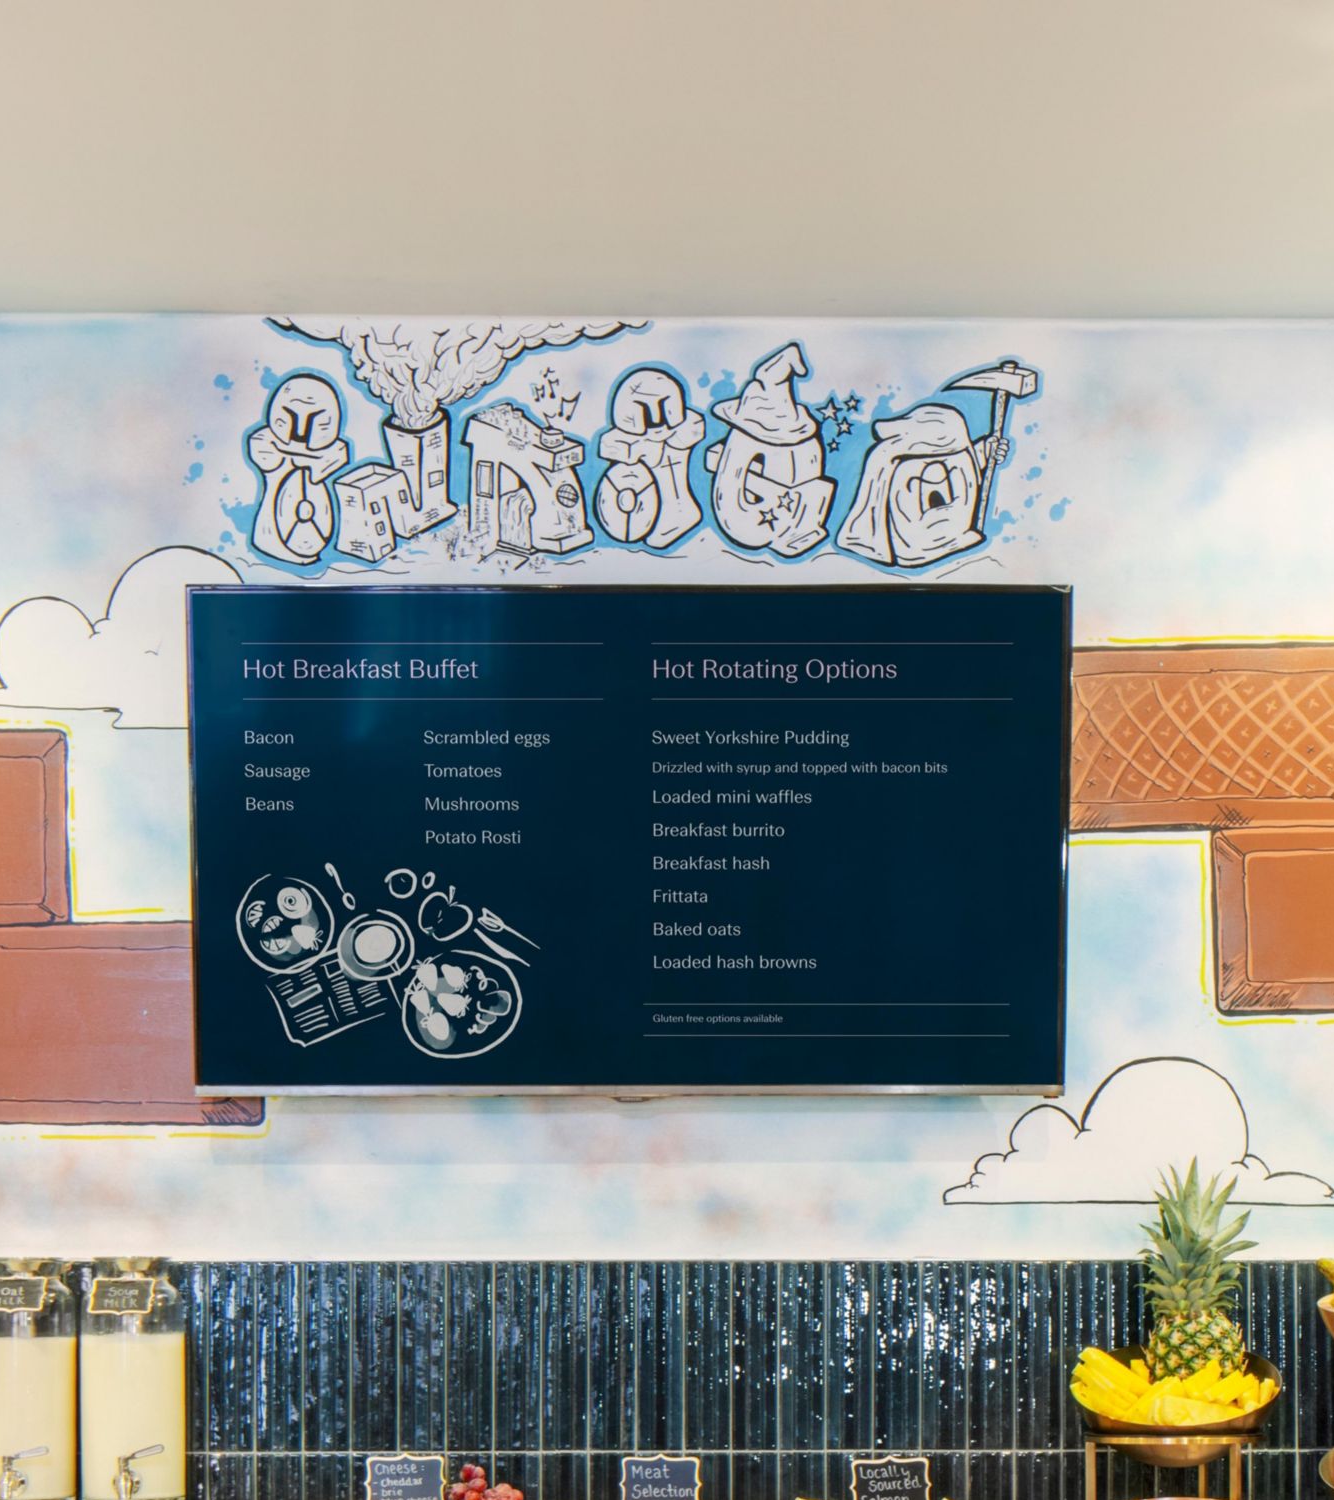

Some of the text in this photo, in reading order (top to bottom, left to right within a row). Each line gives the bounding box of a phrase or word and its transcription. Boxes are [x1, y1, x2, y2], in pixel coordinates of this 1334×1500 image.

[243, 658, 478, 679] Hot Breakfast Buffet
[653, 658, 898, 684] Hot Rotating Options
[244, 730, 294, 745] Bacon
[423, 730, 551, 748] Scrambled eggs
[651, 730, 850, 748] Sweet Yorkshire Pudding
[244, 763, 311, 782] Sausage
[424, 763, 502, 778] Tomatoes
[652, 761, 948, 776] Drizzled with syrup and topped with bacon bits
[245, 796, 295, 811] Beans
[425, 796, 520, 811] Mushrooms
[652, 789, 812, 804] Loaded mini waffles
[652, 822, 785, 837] Breakfast burrito
[425, 830, 521, 845] Potato Rosti
[653, 855, 770, 870] Breakfast hash
[653, 889, 708, 903] Frittata
[653, 921, 741, 937] Baked oats
[653, 954, 817, 969] Loaded hash browns
[652, 1013, 784, 1025] Gluten free options available
[0, 1286, 25, 1296] Oat
[108, 1286, 139, 1298] Soya
[631, 1464, 671, 1479] Meat
[381, 1487, 403, 1497] brie
[631, 1483, 695, 1499] Selection
